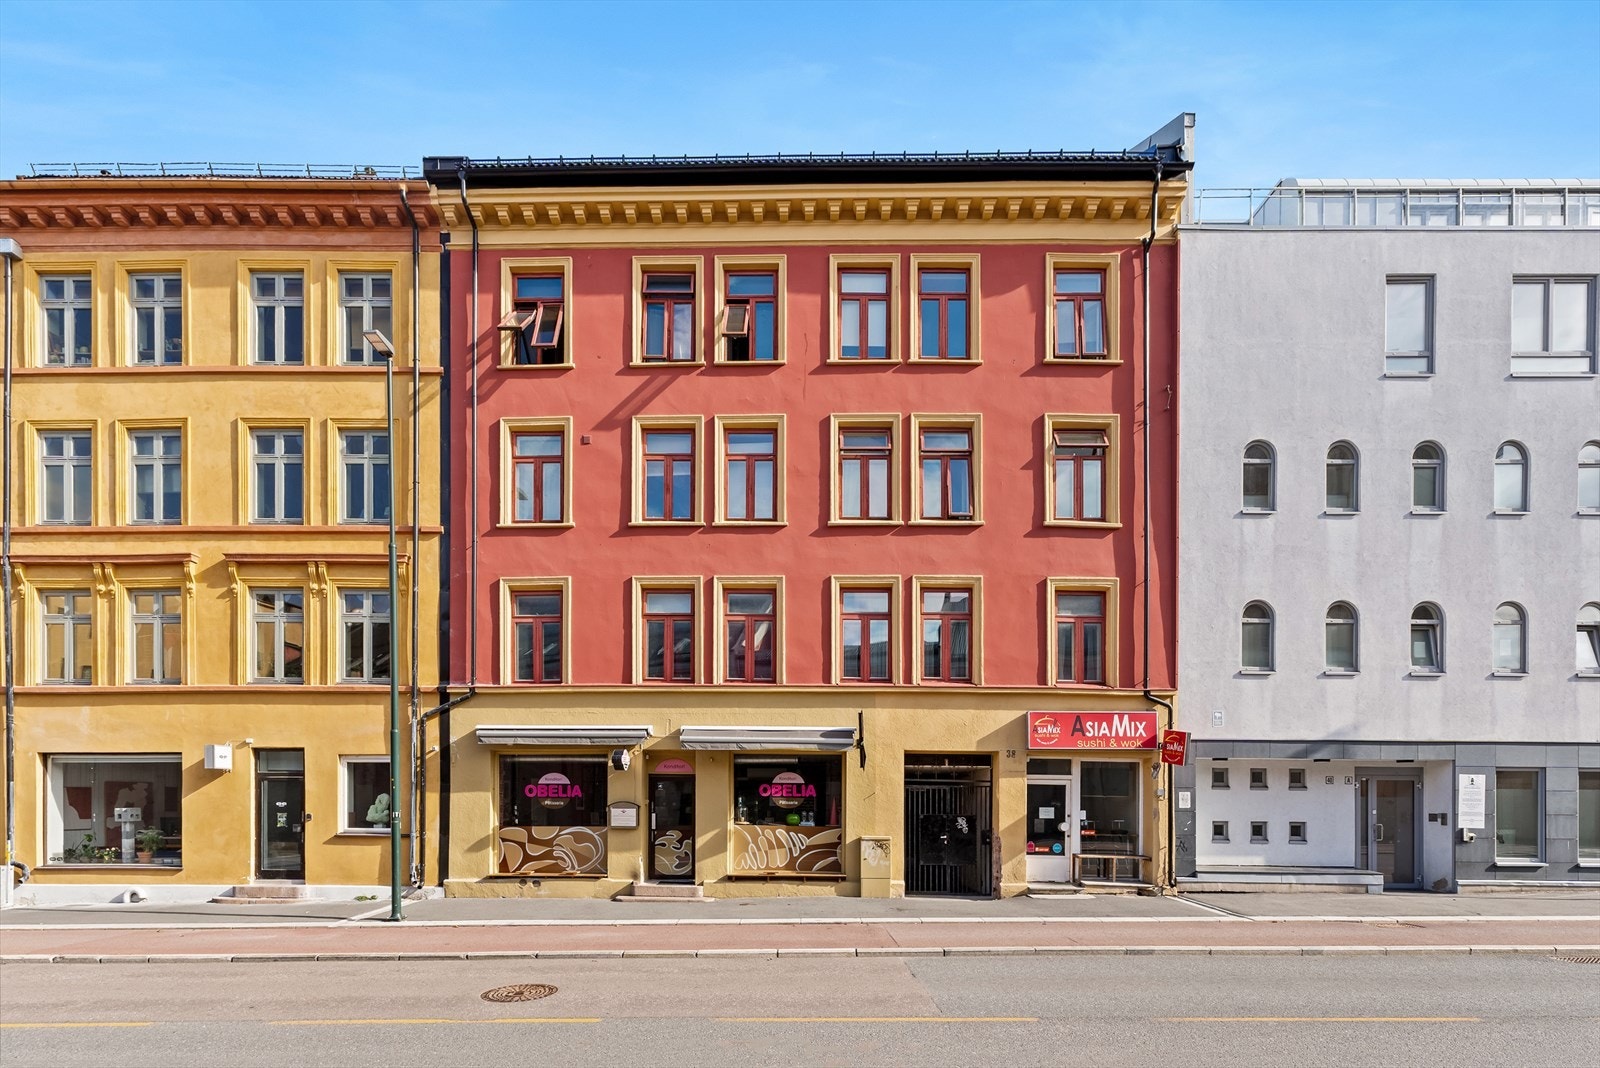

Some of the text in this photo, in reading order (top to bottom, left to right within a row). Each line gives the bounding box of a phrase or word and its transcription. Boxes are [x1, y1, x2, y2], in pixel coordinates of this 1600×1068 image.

[1077, 738, 1143, 748] sushi & wok
[1006, 749, 1016, 759] 38
[524, 784, 582, 798] OBELIA
[758, 783, 816, 797] OBELIA
